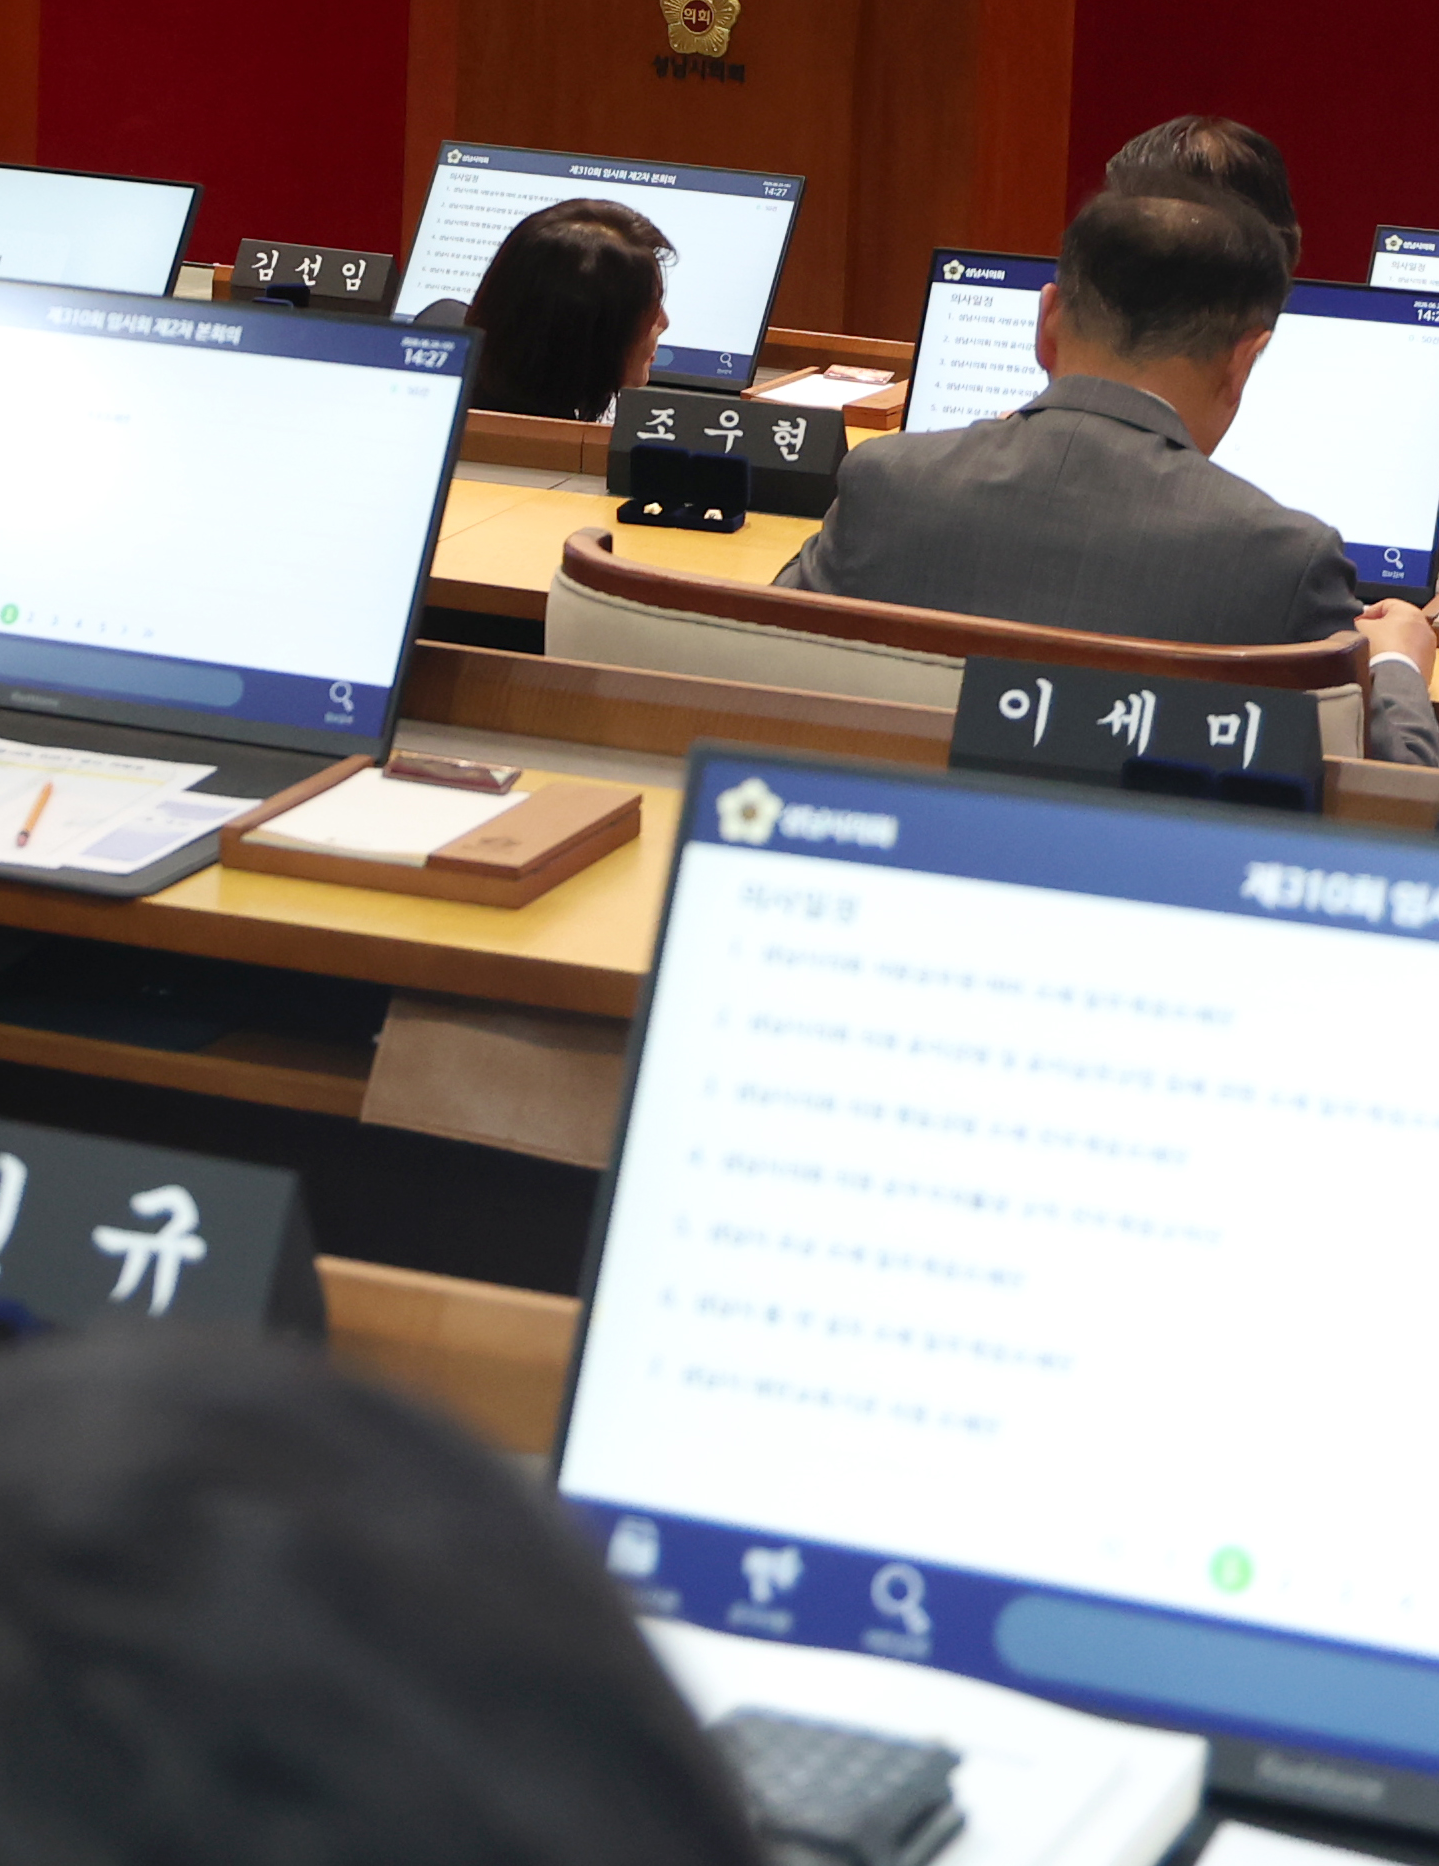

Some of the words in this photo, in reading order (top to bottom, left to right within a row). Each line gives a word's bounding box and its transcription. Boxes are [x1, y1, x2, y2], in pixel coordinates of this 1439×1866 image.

[684, 7, 711, 25] 의회
[462, 154, 489, 164] 성남시의회
[450, 173, 479, 183] 의사일정
[569, 165, 601, 177] 제310회
[603, 167, 627, 180] 임시회
[628, 170, 651, 182] 제2차
[651, 173, 676, 185] 본회의
[763, 186, 787, 197] 14:27
[1403, 241, 1435, 251] 성남시의회
[250, 249, 367, 292] 김선임
[1391, 261, 1426, 272] 의사일정
[965, 267, 1005, 281] 성남시의회
[951, 293, 994, 307] 의사일정
[46, 304, 104, 329] 제310회
[106, 311, 151, 336] 임시회
[153, 316, 193, 340] 제2차
[194, 321, 243, 346] 본회의
[958, 313, 995, 324] 성남시의회
[954, 336, 991, 347] 성남시의회
[993, 340, 1008, 349] 의원
[404, 349, 447, 369] 14:27
[950, 359, 987, 370] 성남시의회
[989, 362, 1004, 371] 의원
[946, 382, 983, 393] 성남시의회
[985, 385, 1000, 394] 의원
[942, 405, 964, 415] 성남시
[637, 407, 808, 462] 조우현
[998, 677, 1261, 769] 이세미
[1242, 859, 1389, 927] 제310회
